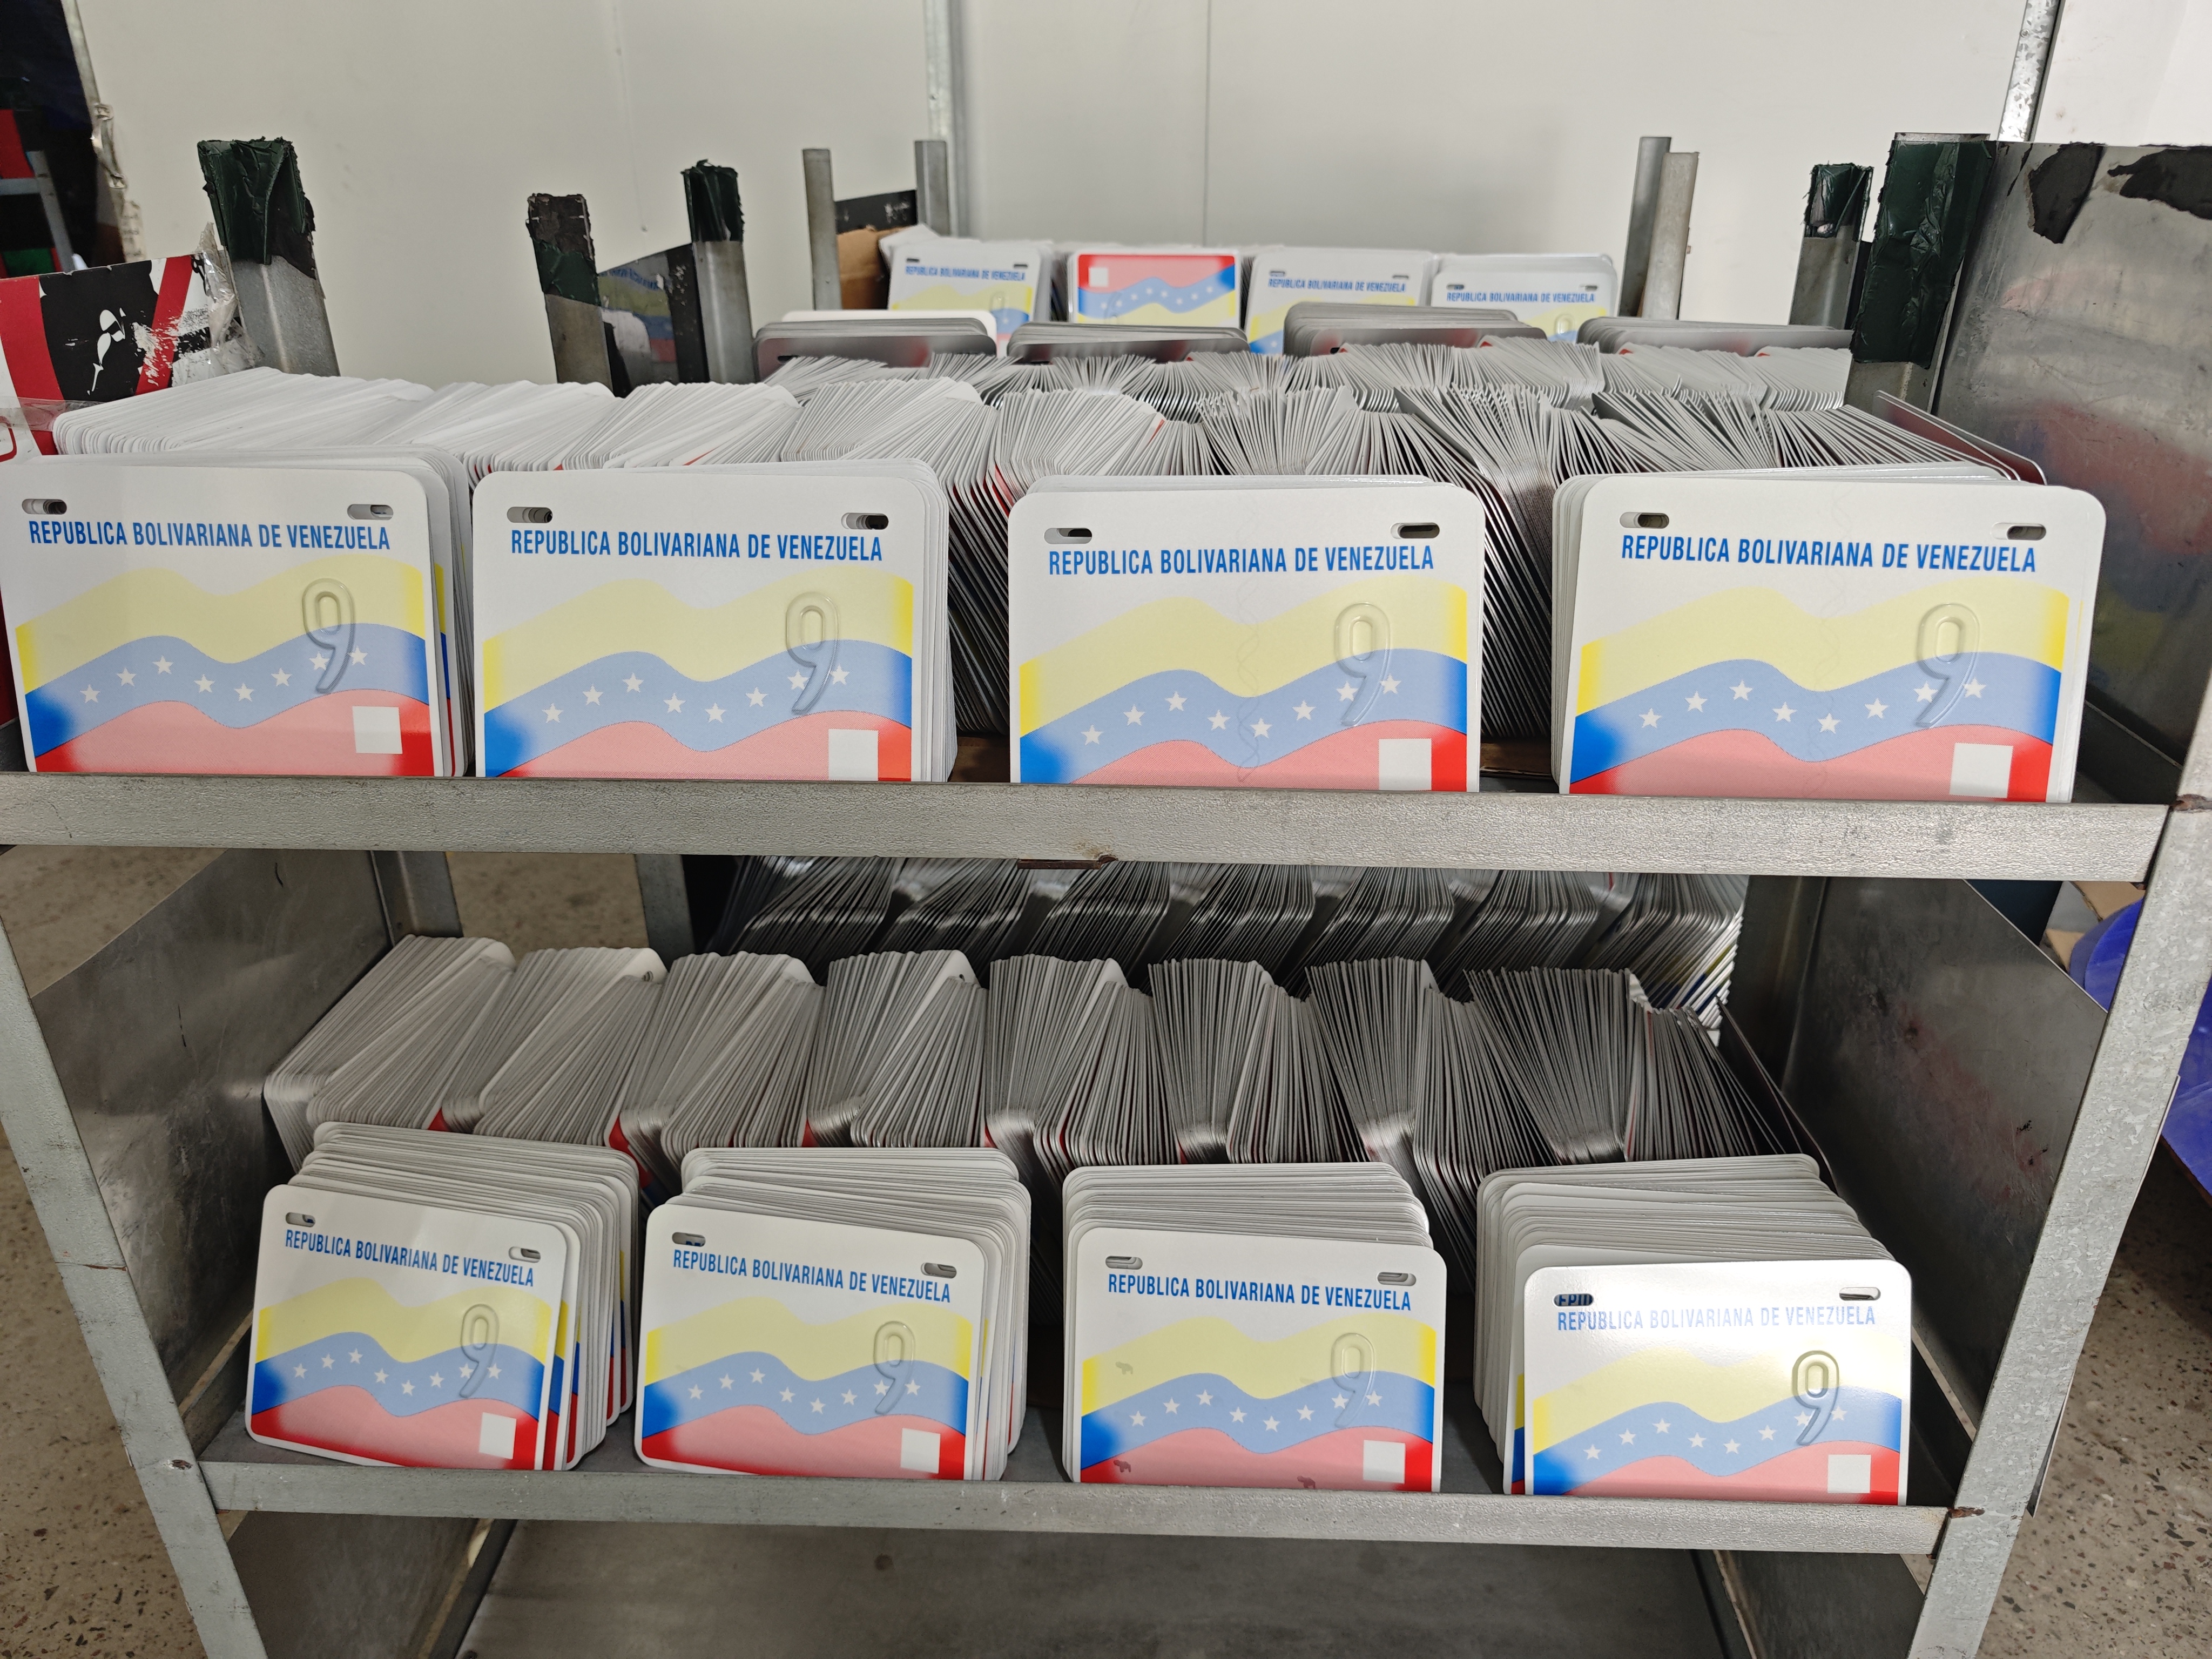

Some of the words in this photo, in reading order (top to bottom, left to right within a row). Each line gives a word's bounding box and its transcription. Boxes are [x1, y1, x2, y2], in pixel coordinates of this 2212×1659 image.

[905, 265, 938, 276] REPUBLICA
[940, 267, 979, 278] BOLIVARIANA
[982, 269, 989, 279] DE
[992, 270, 1025, 281] VENEZUELA
[1268, 278, 1305, 289] REPUBLICA
[1308, 279, 1353, 291] BOLIVARIANA
[1355, 281, 1364, 291] DE
[1367, 281, 1406, 292] VENEZUELA
[1447, 292, 1486, 302] REPUBLICA
[1490, 292, 1537, 302] BOLIVARIANA
[1541, 293, 1550, 302] DE
[1553, 293, 1595, 302] VENEZUELA
[29, 521, 127, 544] REPUBLICA
[133, 522, 252, 547] BOLIVARIANA
[259, 524, 282, 548] DE
[286, 525, 390, 550] VENEZUELA
[511, 529, 610, 555] REPUBLICA
[618, 531, 740, 558] BOLIVARIANA
[747, 534, 771, 559] DE
[777, 535, 882, 561] VENEZUELA
[1049, 550, 1152, 575] REPUBLICA
[1161, 548, 1287, 574] BOLIVARIANA
[1294, 547, 1318, 572] DE
[1325, 545, 1434, 571] VENEZUELA
[1621, 535, 1729, 562] REPUBLICA
[1737, 538, 1873, 568] BOLIVARIANA
[1881, 543, 1908, 569] DE
[1916, 544, 2036, 573] VENEZUELA
[302, 578, 356, 693] 9
[786, 591, 839, 714] 9
[1334, 602, 1390, 727] 9
[1917, 603, 1980, 729] 9
[285, 1229, 350, 1258] REPUBLICA
[355, 1240, 437, 1271] BOLIVARIANA
[443, 1255, 458, 1276] DE
[463, 1257, 534, 1287] VENEZUELA
[673, 1249, 747, 1276] REPUBLICA
[752, 1259, 844, 1289] BOLIVARIANA
[849, 1271, 866, 1292] DE
[872, 1273, 950, 1303] VENEZUELA
[1108, 1273, 1189, 1297] REPUBLICA
[1195, 1279, 1295, 1304] BOLIVARIANA
[1301, 1284, 1320, 1306] DE
[1325, 1286, 1411, 1311] VENEZUELA
[1557, 1310, 1643, 1331] REPUBLICA
[1650, 1309, 1754, 1328] BOLIVARIANA
[1761, 1307, 1781, 1326] DE
[1785, 1305, 1876, 1326] VENEZUELA
[460, 1304, 500, 1398] 9
[873, 1320, 916, 1415] 9
[1331, 1333, 1376, 1428] 9
[1791, 1351, 1840, 1446] 9
